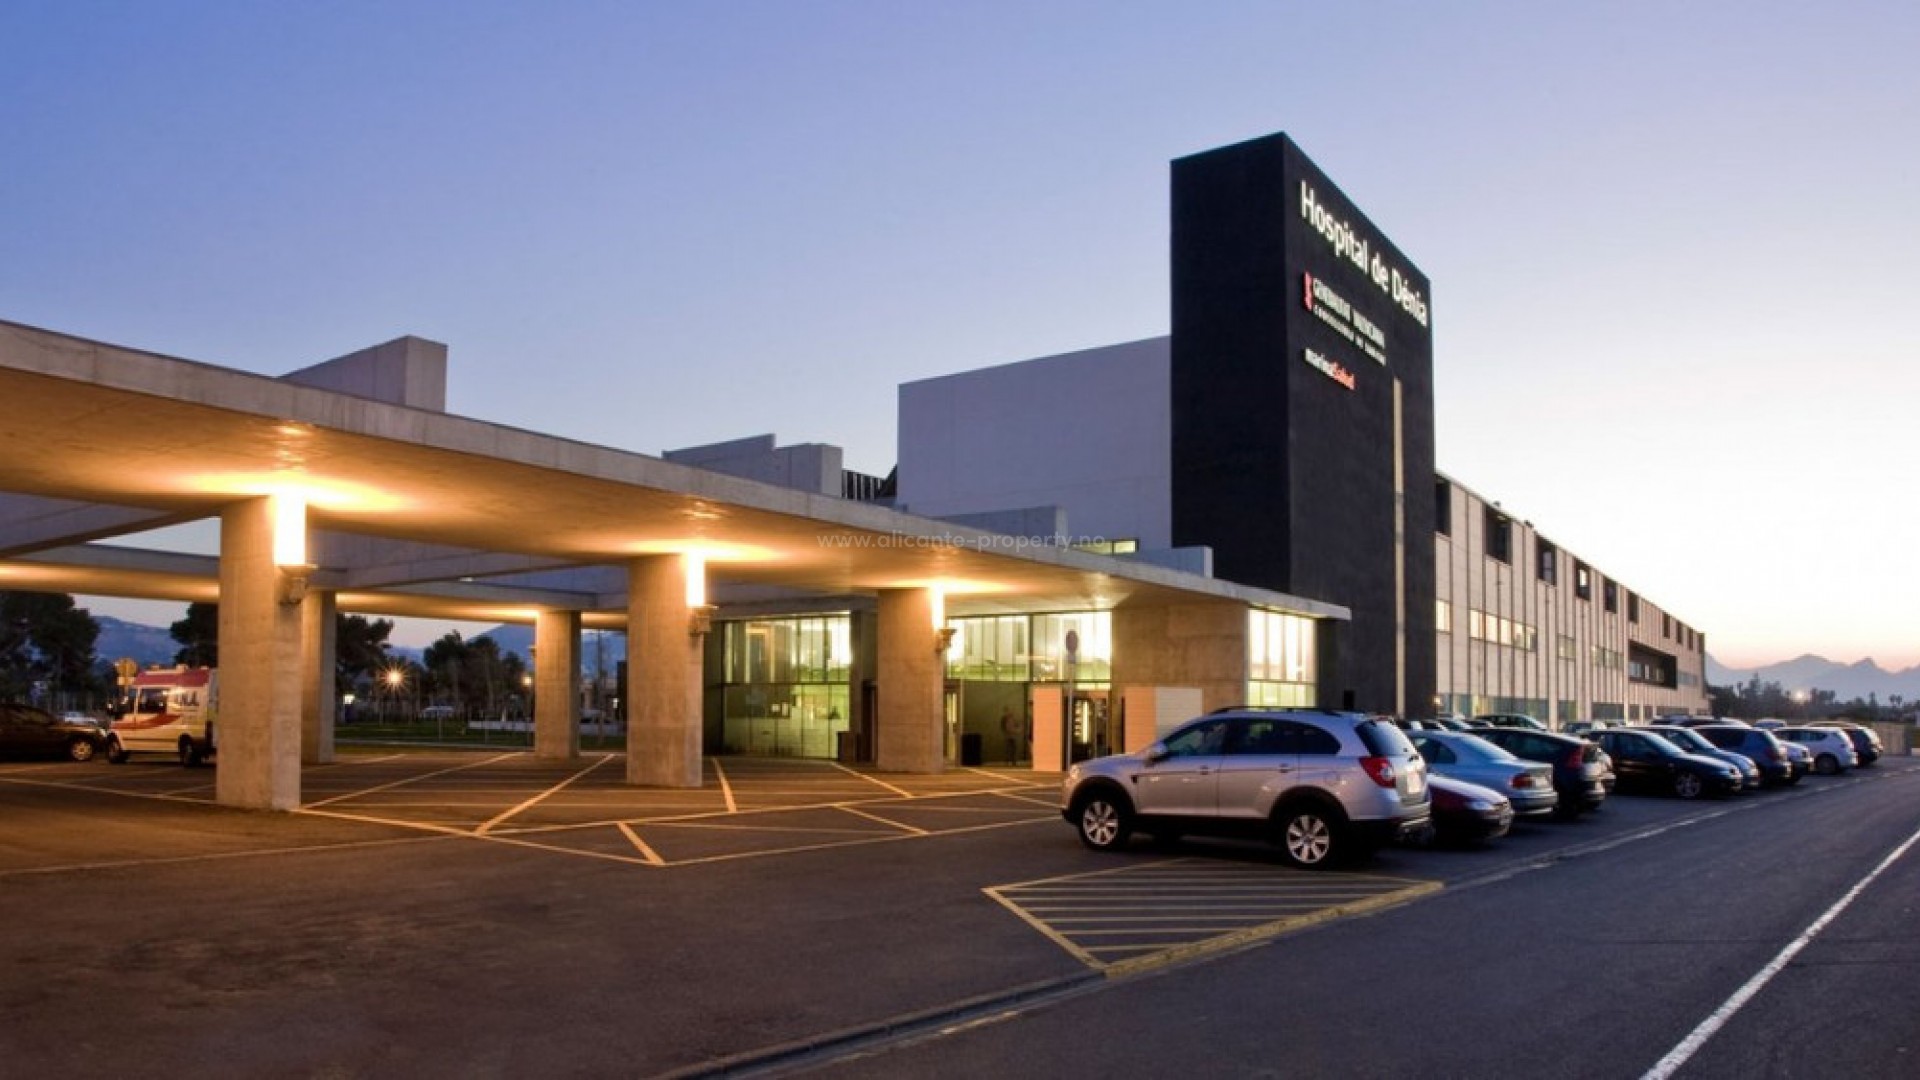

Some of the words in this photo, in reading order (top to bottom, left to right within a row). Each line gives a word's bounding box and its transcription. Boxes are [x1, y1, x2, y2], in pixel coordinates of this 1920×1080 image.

[1300, 179, 1369, 275] Hospital
[1371, 252, 1389, 293] de
[1392, 267, 1428, 327] Dénia
